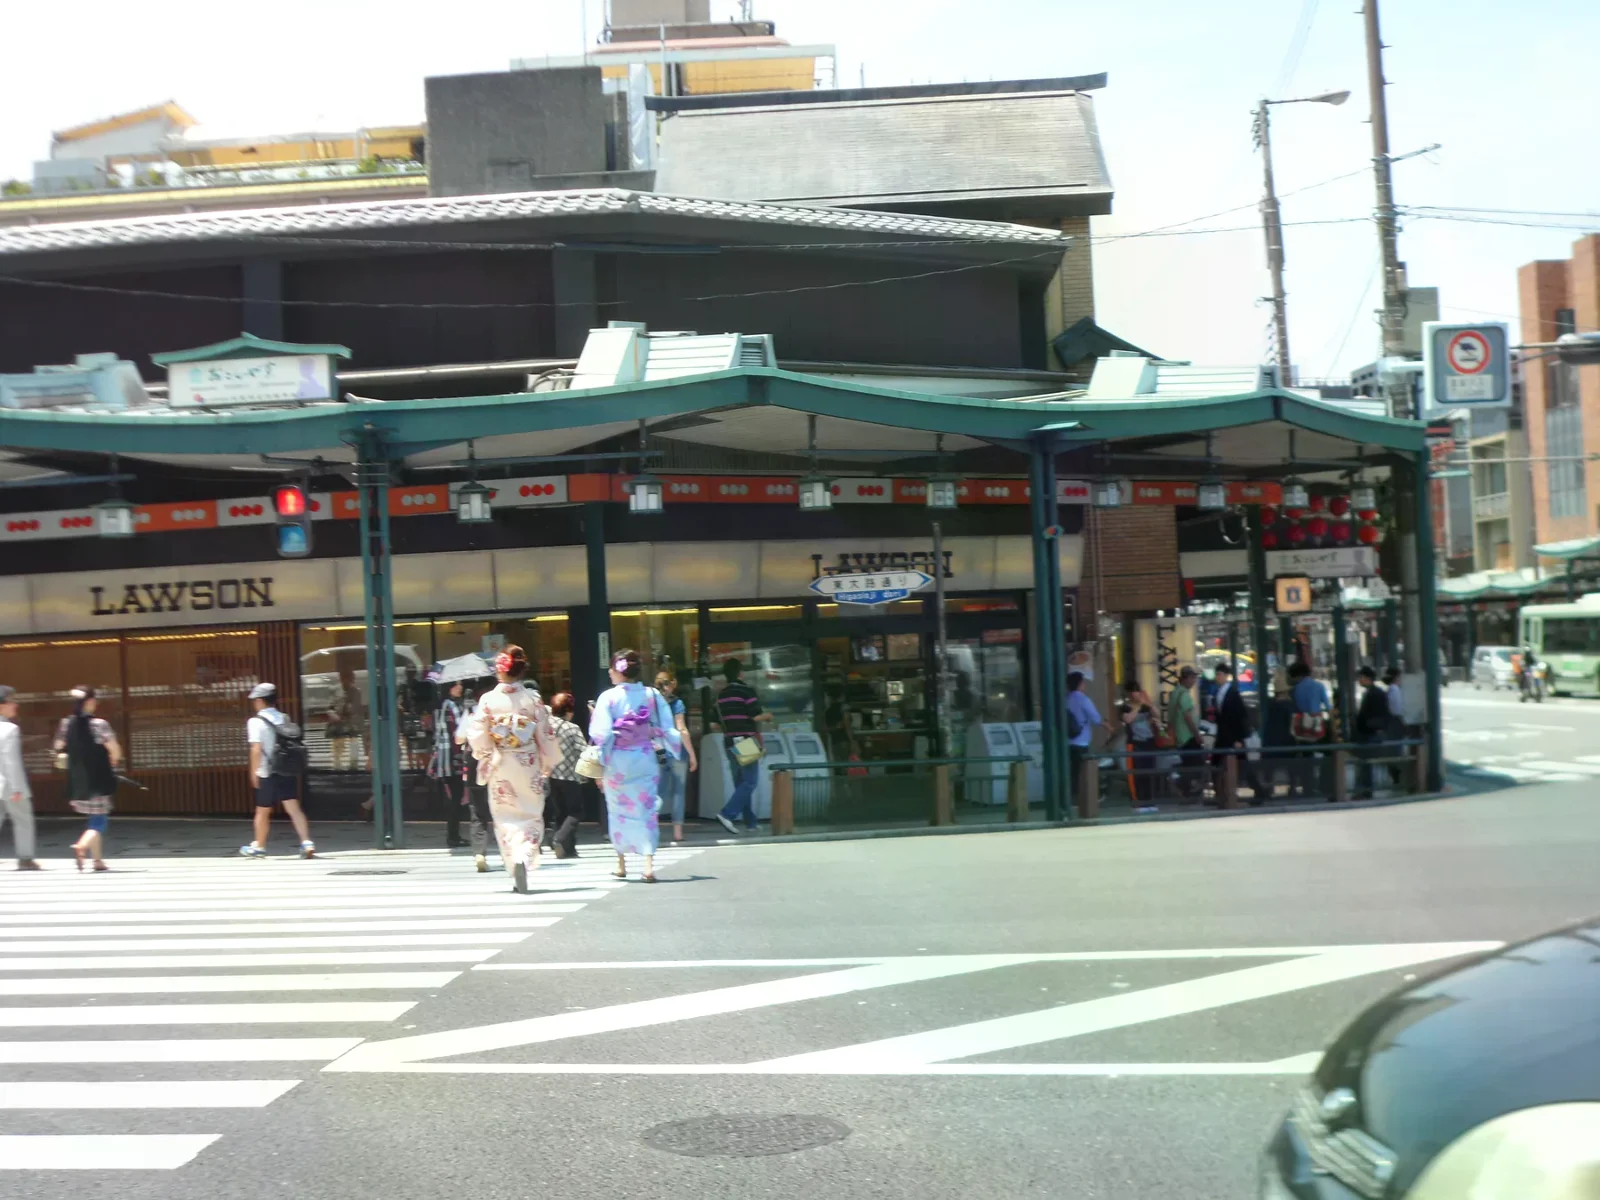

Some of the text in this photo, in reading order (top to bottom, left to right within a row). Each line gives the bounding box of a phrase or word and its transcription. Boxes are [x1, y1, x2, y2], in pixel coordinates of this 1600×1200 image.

[89, 577, 275, 616] LAWSON
[833, 575, 906, 590] 東大路通り
[1156, 623, 1180, 726] LAW
